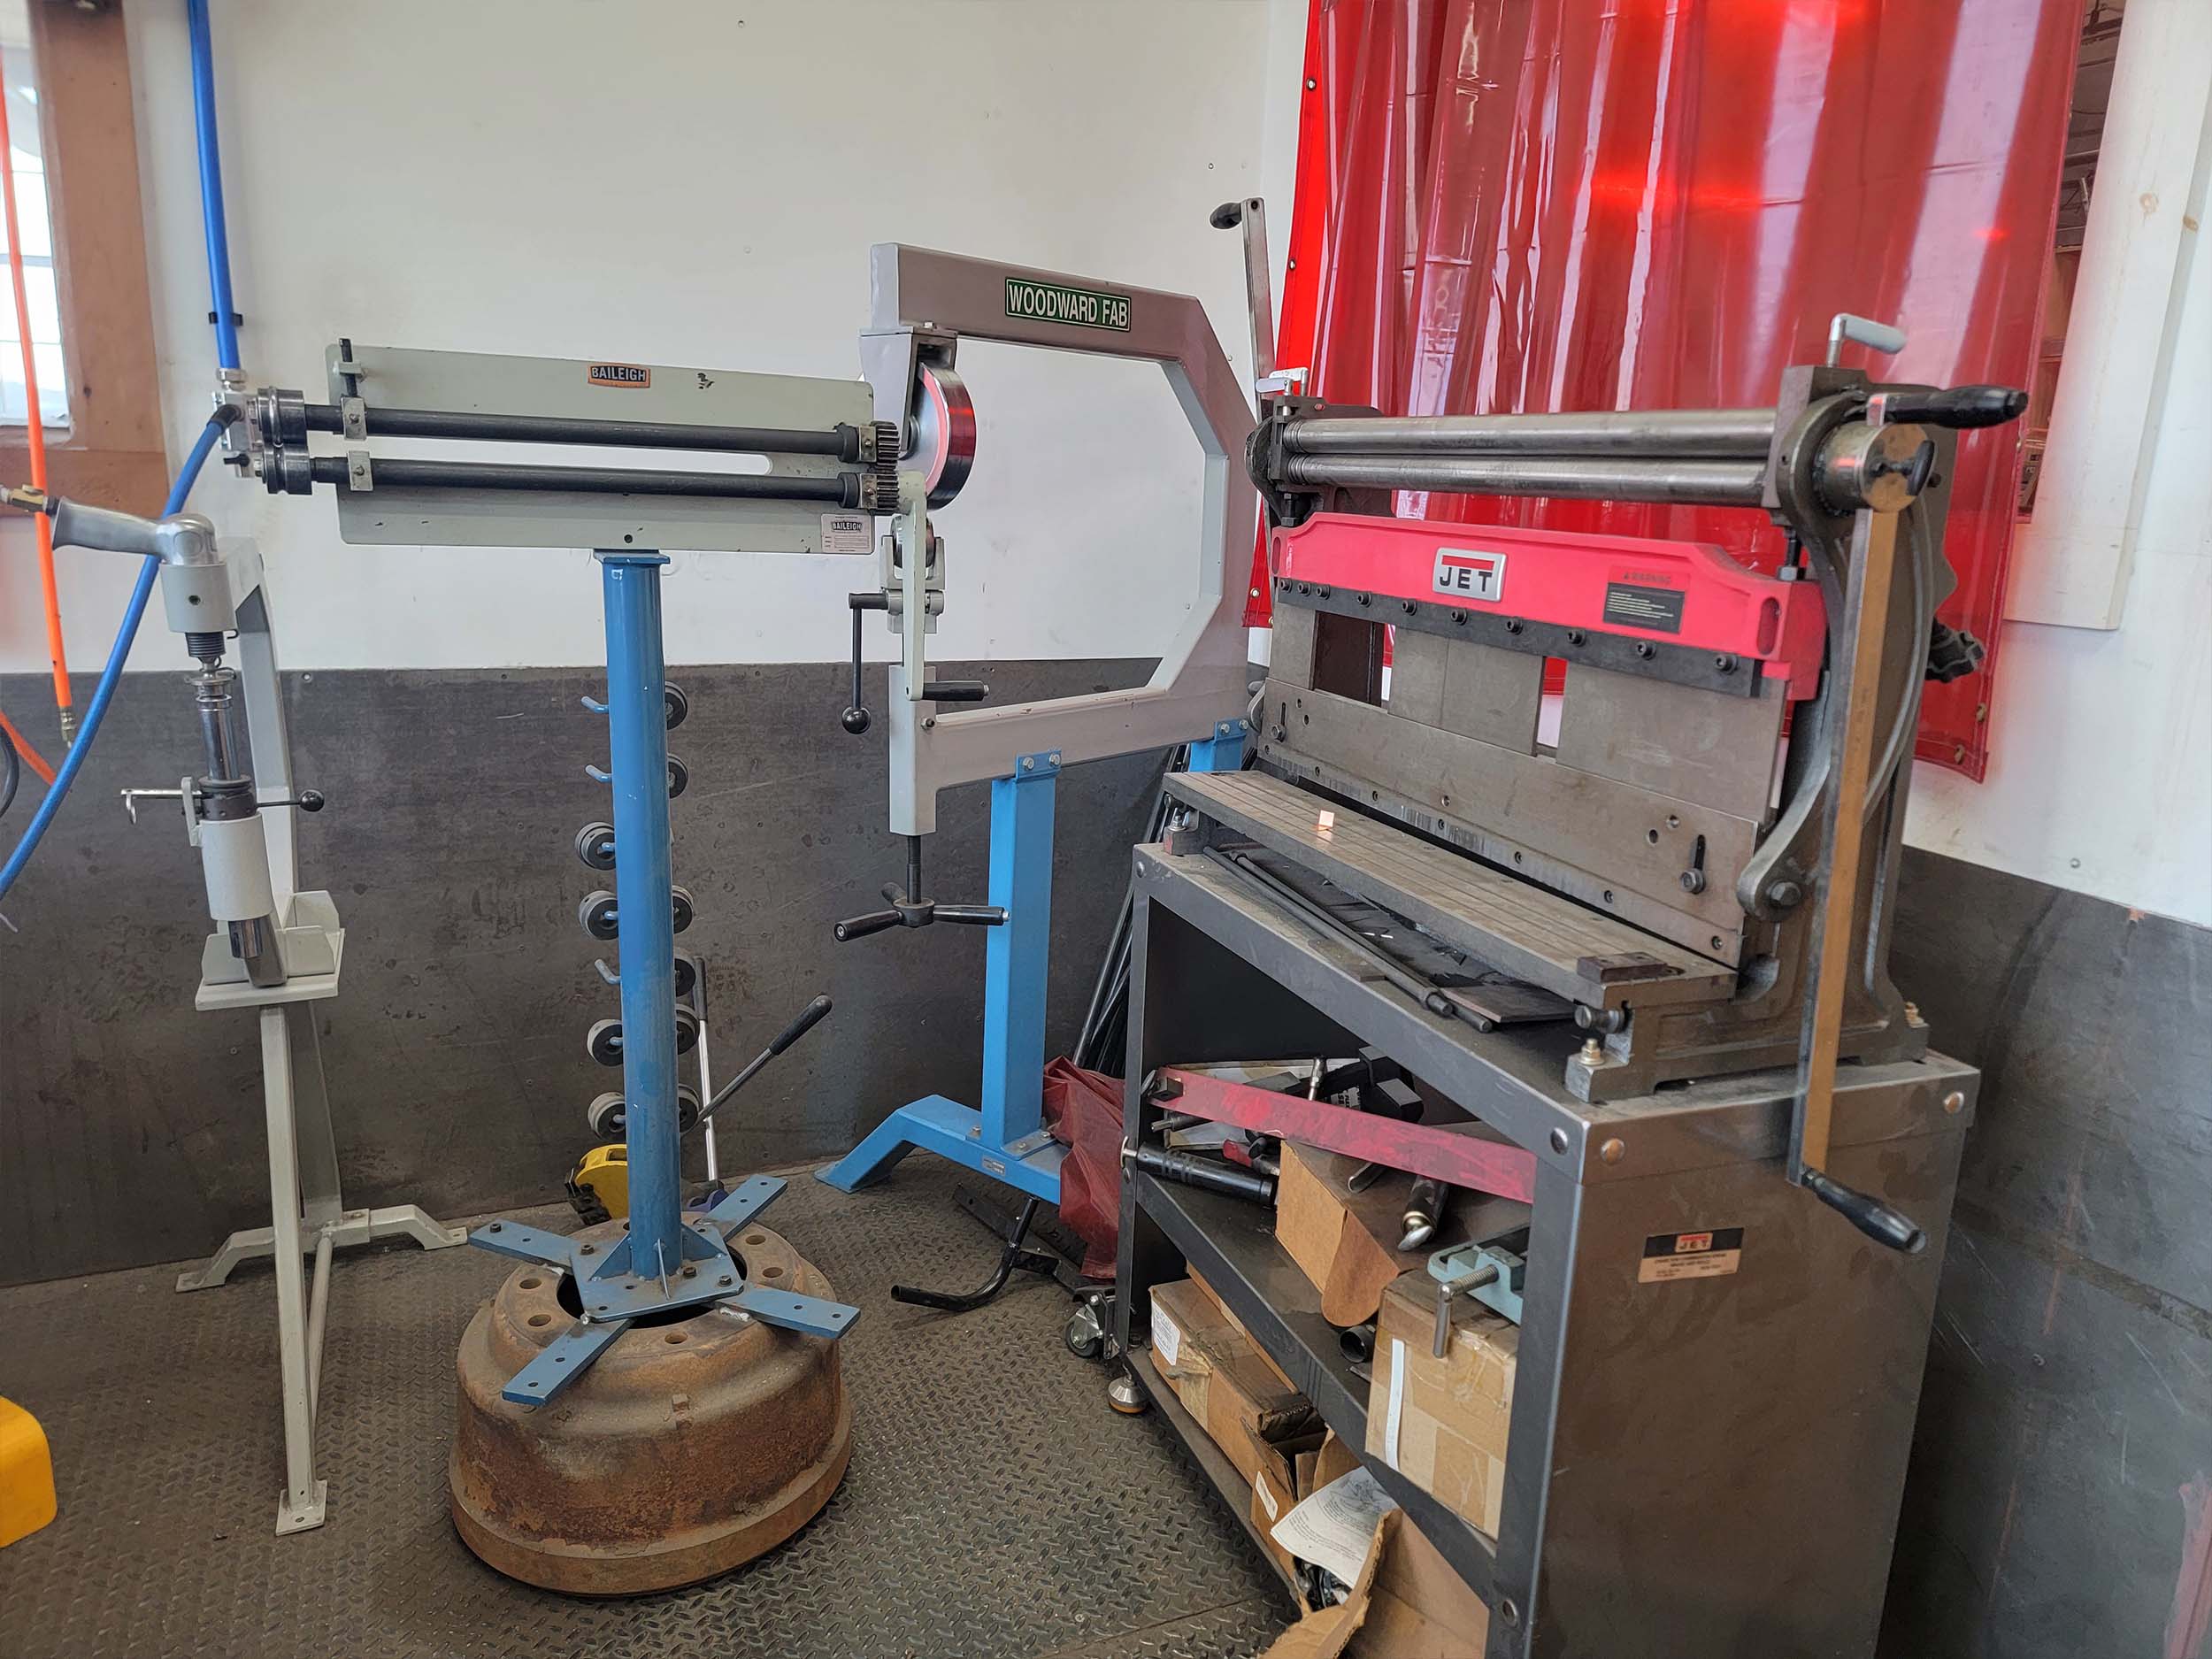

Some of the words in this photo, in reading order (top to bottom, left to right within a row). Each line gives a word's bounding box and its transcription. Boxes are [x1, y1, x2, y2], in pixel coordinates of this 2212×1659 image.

[1009, 284, 1097, 323] WOODWARD
[1102, 299, 1127, 326] FAB
[591, 366, 646, 381] BAILEIGH
[832, 522, 862, 531] BAILEIGH
[1439, 566, 1493, 592] JET
